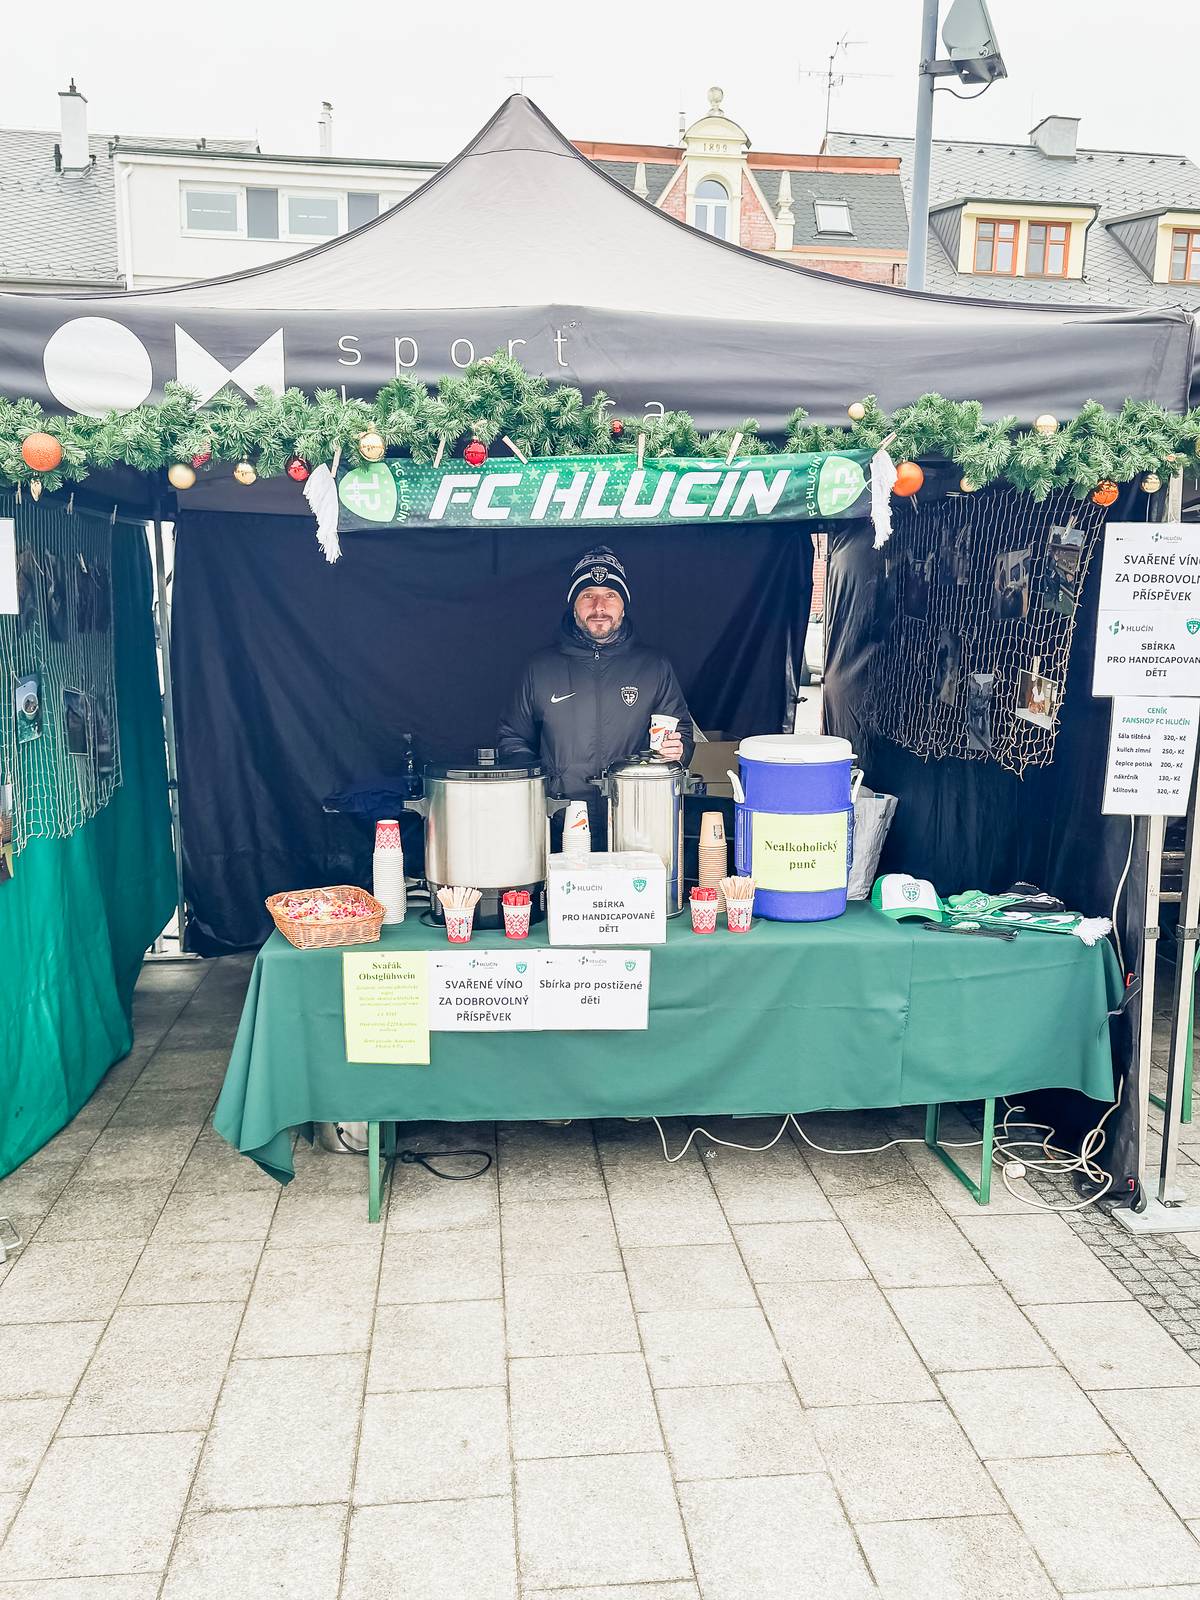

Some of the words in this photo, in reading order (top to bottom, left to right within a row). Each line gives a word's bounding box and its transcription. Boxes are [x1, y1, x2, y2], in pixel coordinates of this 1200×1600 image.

[805, 455, 823, 500] HLUČÍN
[428, 472, 522, 520] FC
[530, 460, 793, 520] HLUČÍN
[806, 501, 818, 517] FC
[1123, 552, 1176, 565] SVAŘENÉ
[1179, 553, 1200, 565] VÍN
[1115, 573, 1130, 582] ZA
[1132, 588, 1192, 601] PŘÍSPĚVEK
[1126, 624, 1154, 632] HLUČÍN
[1141, 640, 1176, 650] SBÍRKA
[1145, 667, 1167, 677] DĚTI
[1147, 706, 1168, 714] CENÍK
[1165, 717, 1191, 726] HLUČÍN
[1115, 760, 1134, 768] čepice
[764, 839, 838, 853] Nealkoholický
[789, 859, 817, 871] punč
[592, 899, 625, 908] SBÍRKA
[562, 913, 580, 922] PRO
[582, 910, 655, 921] HANDICAPOVANÉ
[598, 923, 619, 933] DĚTI
[372, 961, 402, 970] Svařák
[358, 972, 416, 982] Obstglühwein
[445, 978, 493, 989] SVAŘENÉ
[496, 978, 523, 989] VÍNO
[539, 979, 571, 989] Sbírka
[574, 981, 591, 990] pro
[594, 980, 643, 990] postižené
[438, 997, 453, 1006] ZA
[455, 994, 529, 1006] DOBROVOLNÝ
[580, 995, 601, 1005] děti
[456, 1010, 512, 1021] PŘÍSPĚVEK
